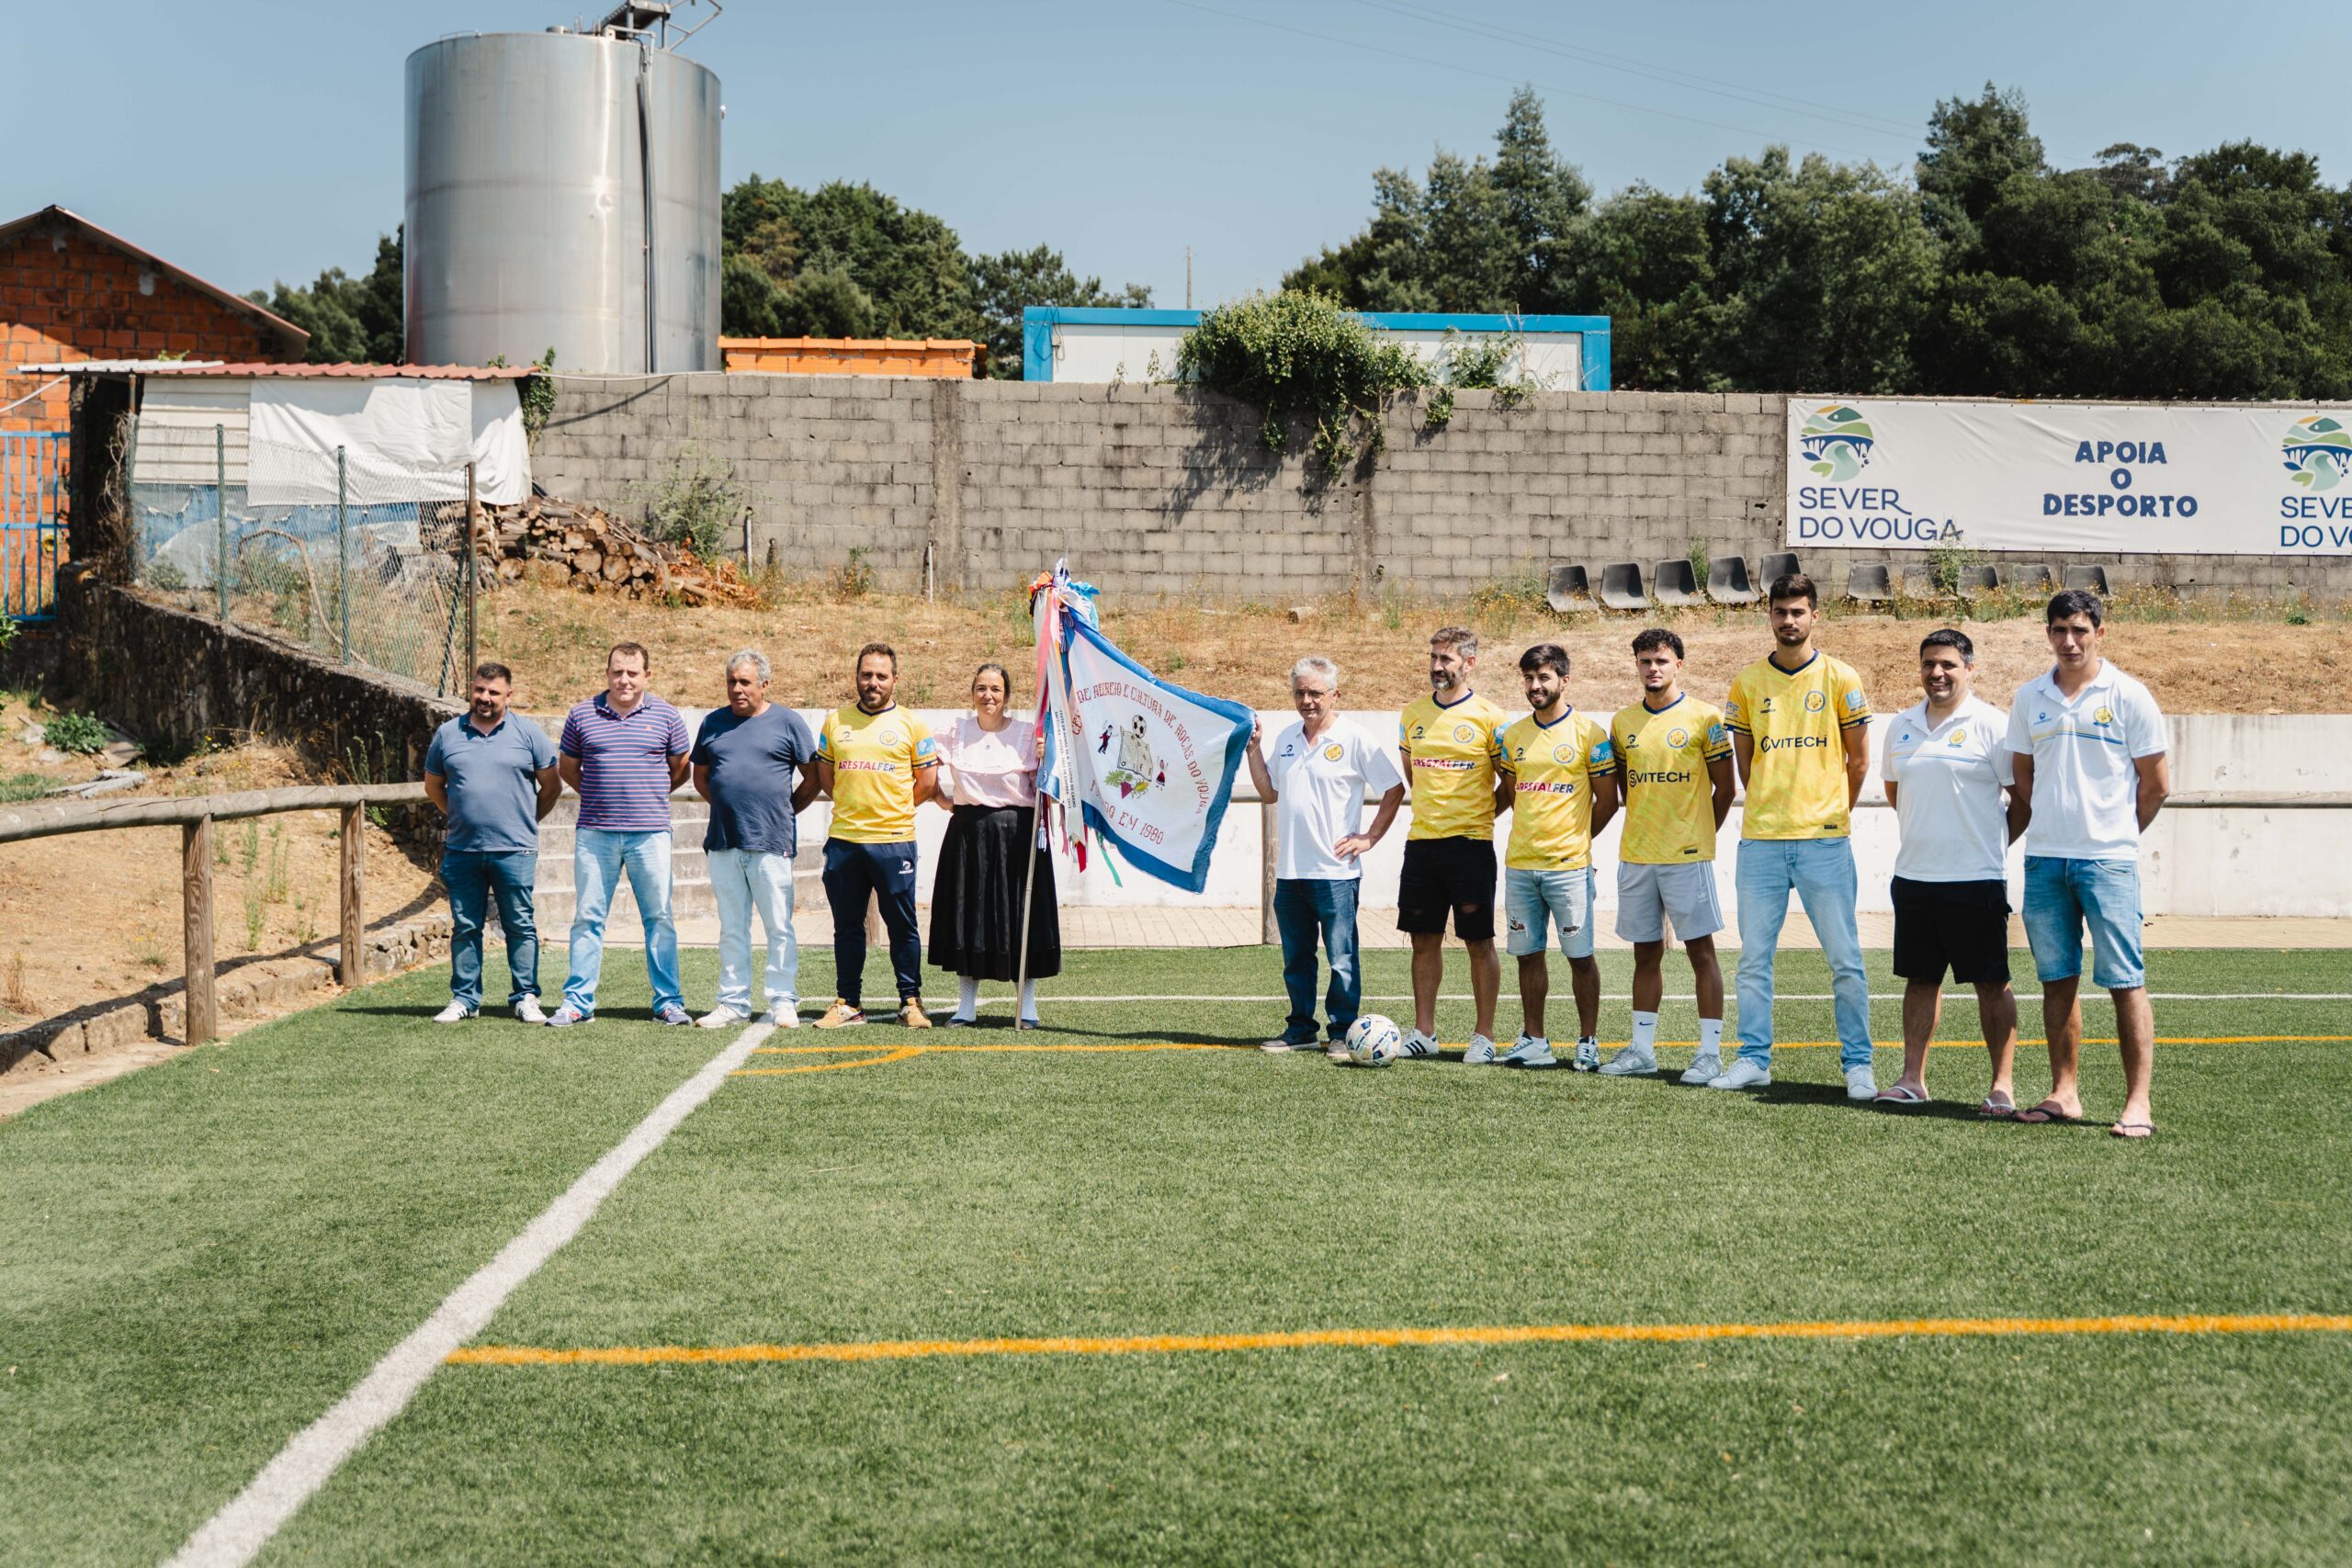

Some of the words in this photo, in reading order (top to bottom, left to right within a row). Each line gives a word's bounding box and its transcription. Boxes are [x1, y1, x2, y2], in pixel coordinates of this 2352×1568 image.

[2075, 441, 2167, 464] APOIA
[2110, 468, 2132, 491] O
[1799, 487, 1912, 515] SEVER
[2043, 493, 2199, 517] DESPORTO
[1800, 516, 1844, 539] DO
[1849, 517, 1963, 541] VOUGA
[2280, 525, 2324, 547] DO
[2328, 525, 2352, 547] V
[1077, 687, 1091, 704] DE
[1124, 684, 1129, 698] E
[1130, 686, 1162, 717] CULTURA
[1163, 710, 1177, 728] DE
[1174, 724, 1194, 761] ROCAS
[1187, 761, 1202, 778] DO
[838, 761, 896, 773] ARESTALFER
[1118, 811, 1138, 830] EM
[1139, 822, 1164, 845] 1980
